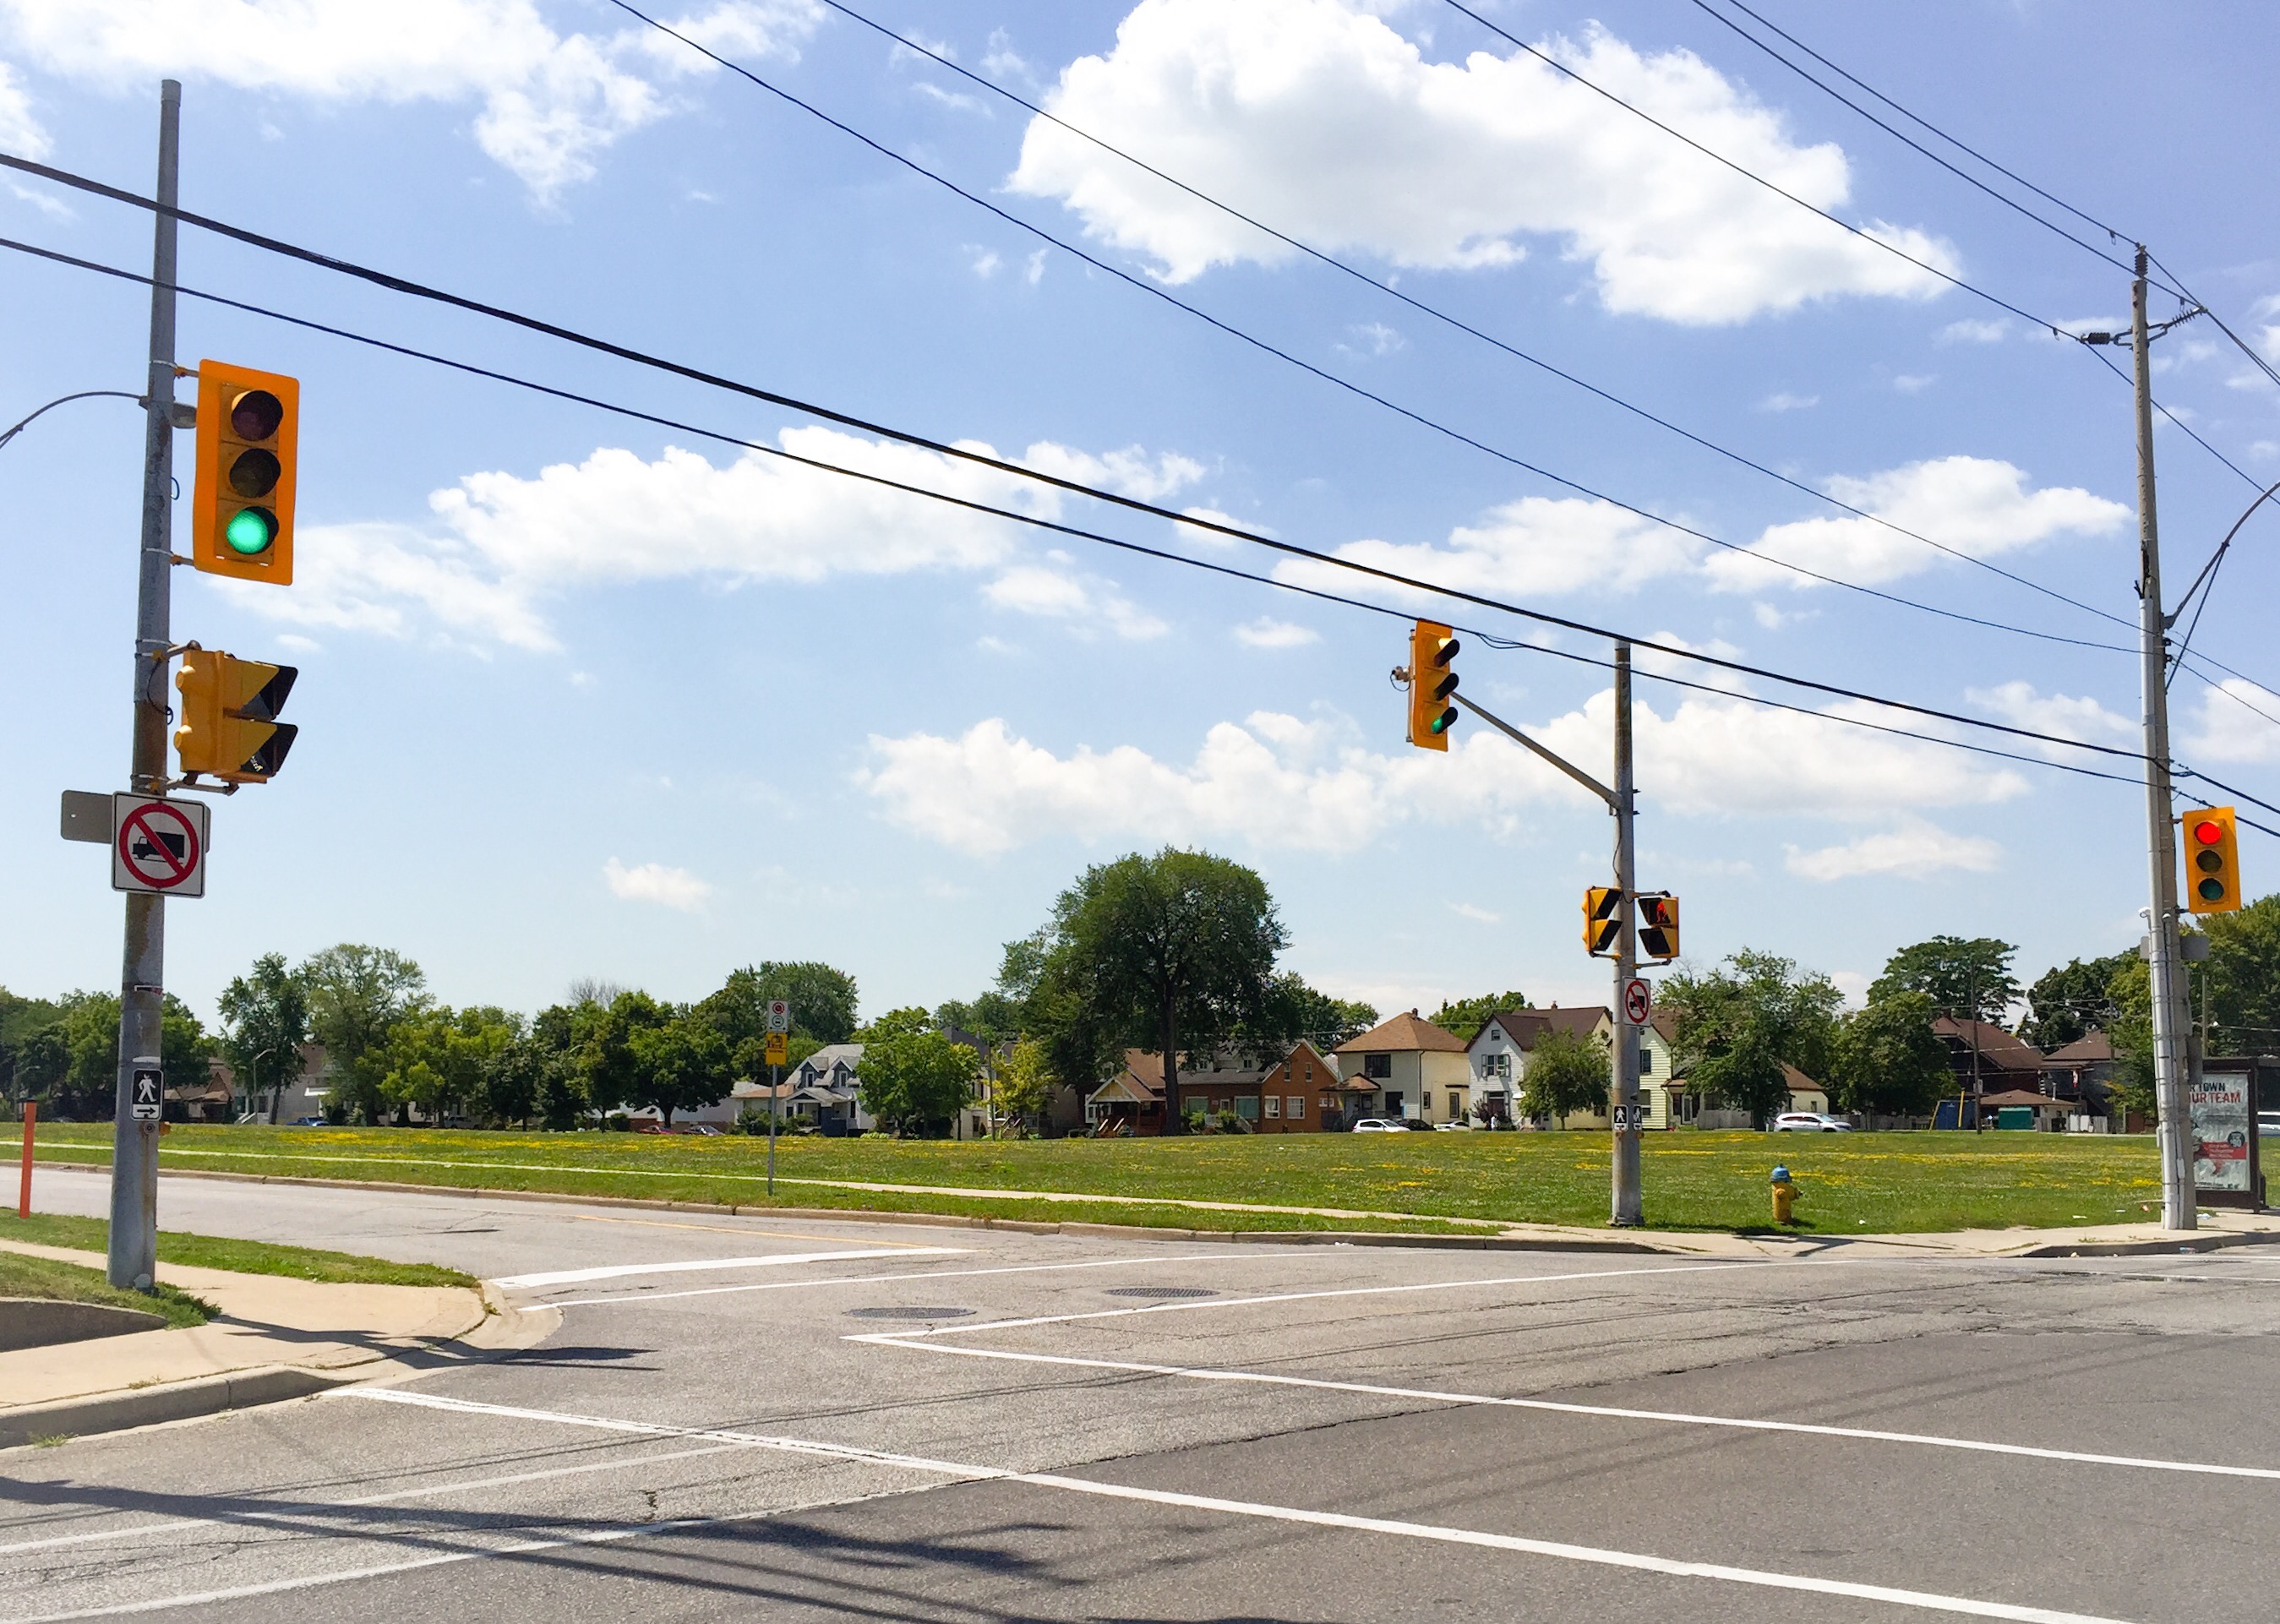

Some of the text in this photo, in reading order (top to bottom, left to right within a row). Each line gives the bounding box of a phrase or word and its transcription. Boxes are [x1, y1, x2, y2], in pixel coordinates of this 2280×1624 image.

[2197, 1082, 2226, 1092] TOWN
[2189, 1092, 2240, 1104] UR TEAM
